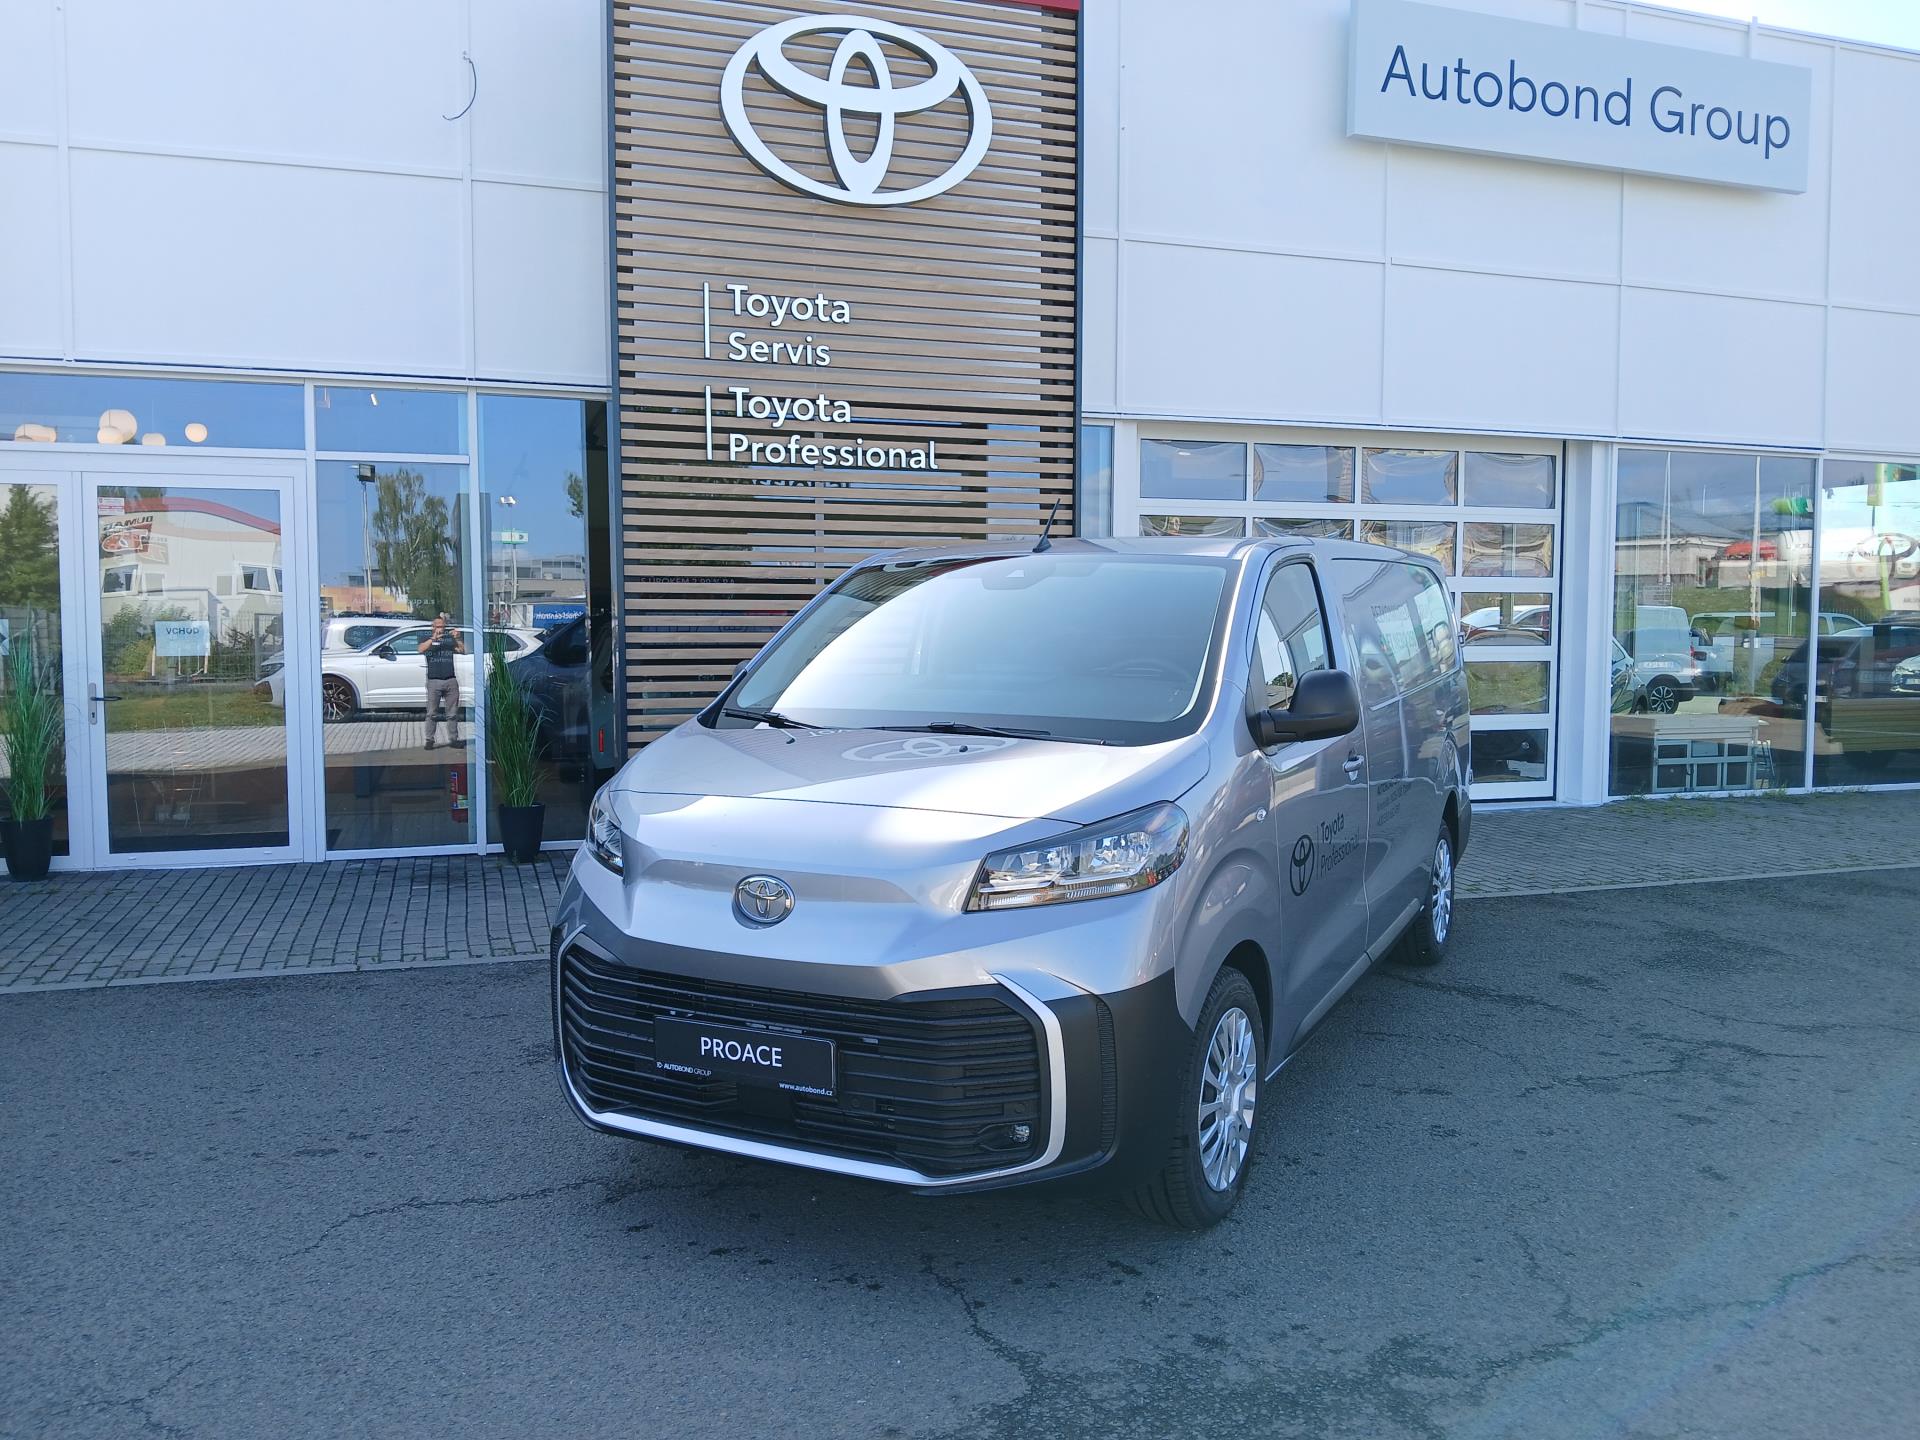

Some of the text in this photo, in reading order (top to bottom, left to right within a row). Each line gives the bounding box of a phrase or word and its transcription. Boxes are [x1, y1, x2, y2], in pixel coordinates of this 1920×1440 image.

[1381, 44, 1792, 160] Autobond Group
[726, 283, 851, 327] Toyota
[727, 331, 832, 367] Servis
[728, 386, 852, 428] Toyota
[729, 433, 939, 470] Professional
[1320, 813, 1345, 844] Toyota
[1320, 831, 1361, 877] Professional
[663, 1063, 712, 1077] AUTOBOND GROUP
[700, 1036, 783, 1068] PROACE
[778, 1082, 833, 1097] www.autobond.cz
